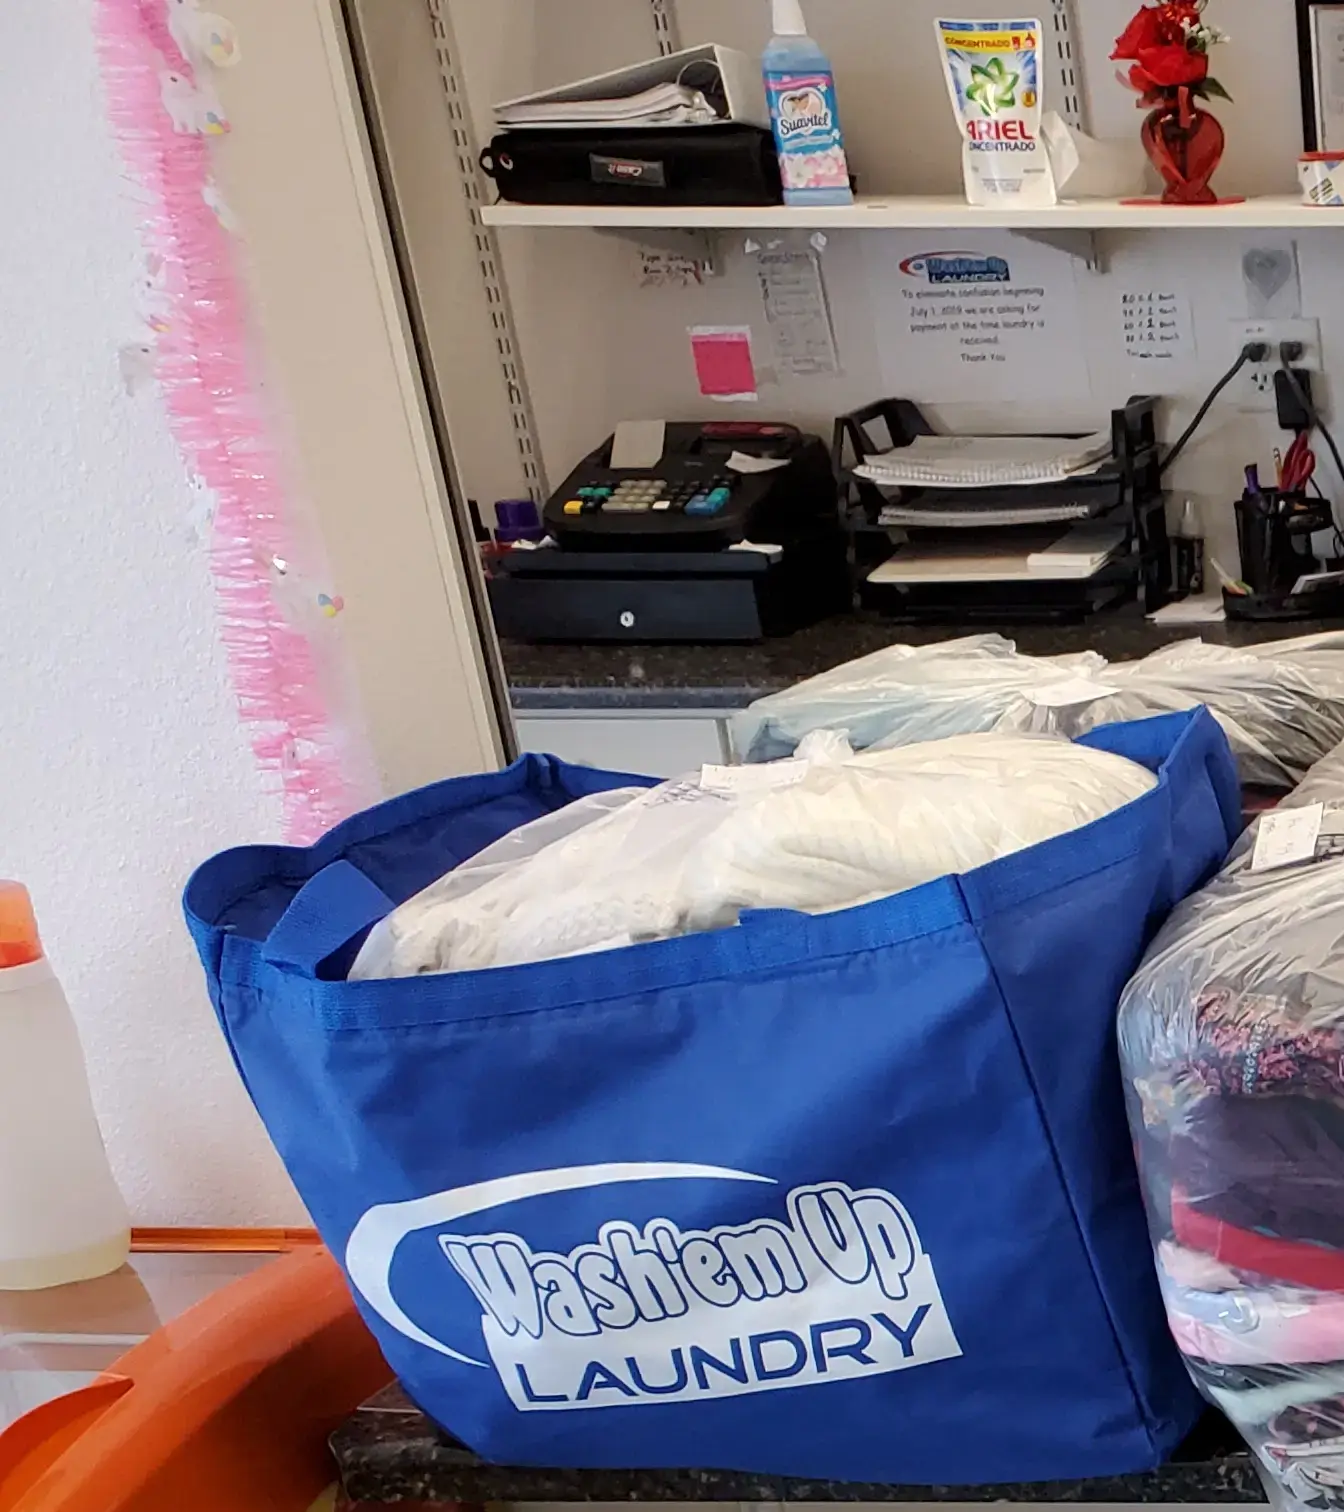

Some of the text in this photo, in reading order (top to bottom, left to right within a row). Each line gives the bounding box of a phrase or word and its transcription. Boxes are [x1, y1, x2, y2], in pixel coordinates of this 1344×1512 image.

[945, 36, 1011, 49] CONCENTRADO
[780, 111, 829, 135] Suavitel
[966, 120, 1035, 140] ARIEL
[968, 141, 1036, 151] ONCENTRADO
[958, 288, 1001, 298] confusion
[1003, 287, 1045, 299] beginning
[910, 306, 928, 318] July
[996, 306, 1024, 318] asking
[1027, 304, 1041, 313] for
[910, 322, 947, 332] payment
[962, 320, 977, 330] the
[980, 320, 999, 330] time
[1002, 320, 1034, 332] laundry
[960, 352, 1006, 362] Thank You
[445, 1184, 918, 1341] Wash'em Up
[512, 1302, 935, 1404] LAUNDRY
